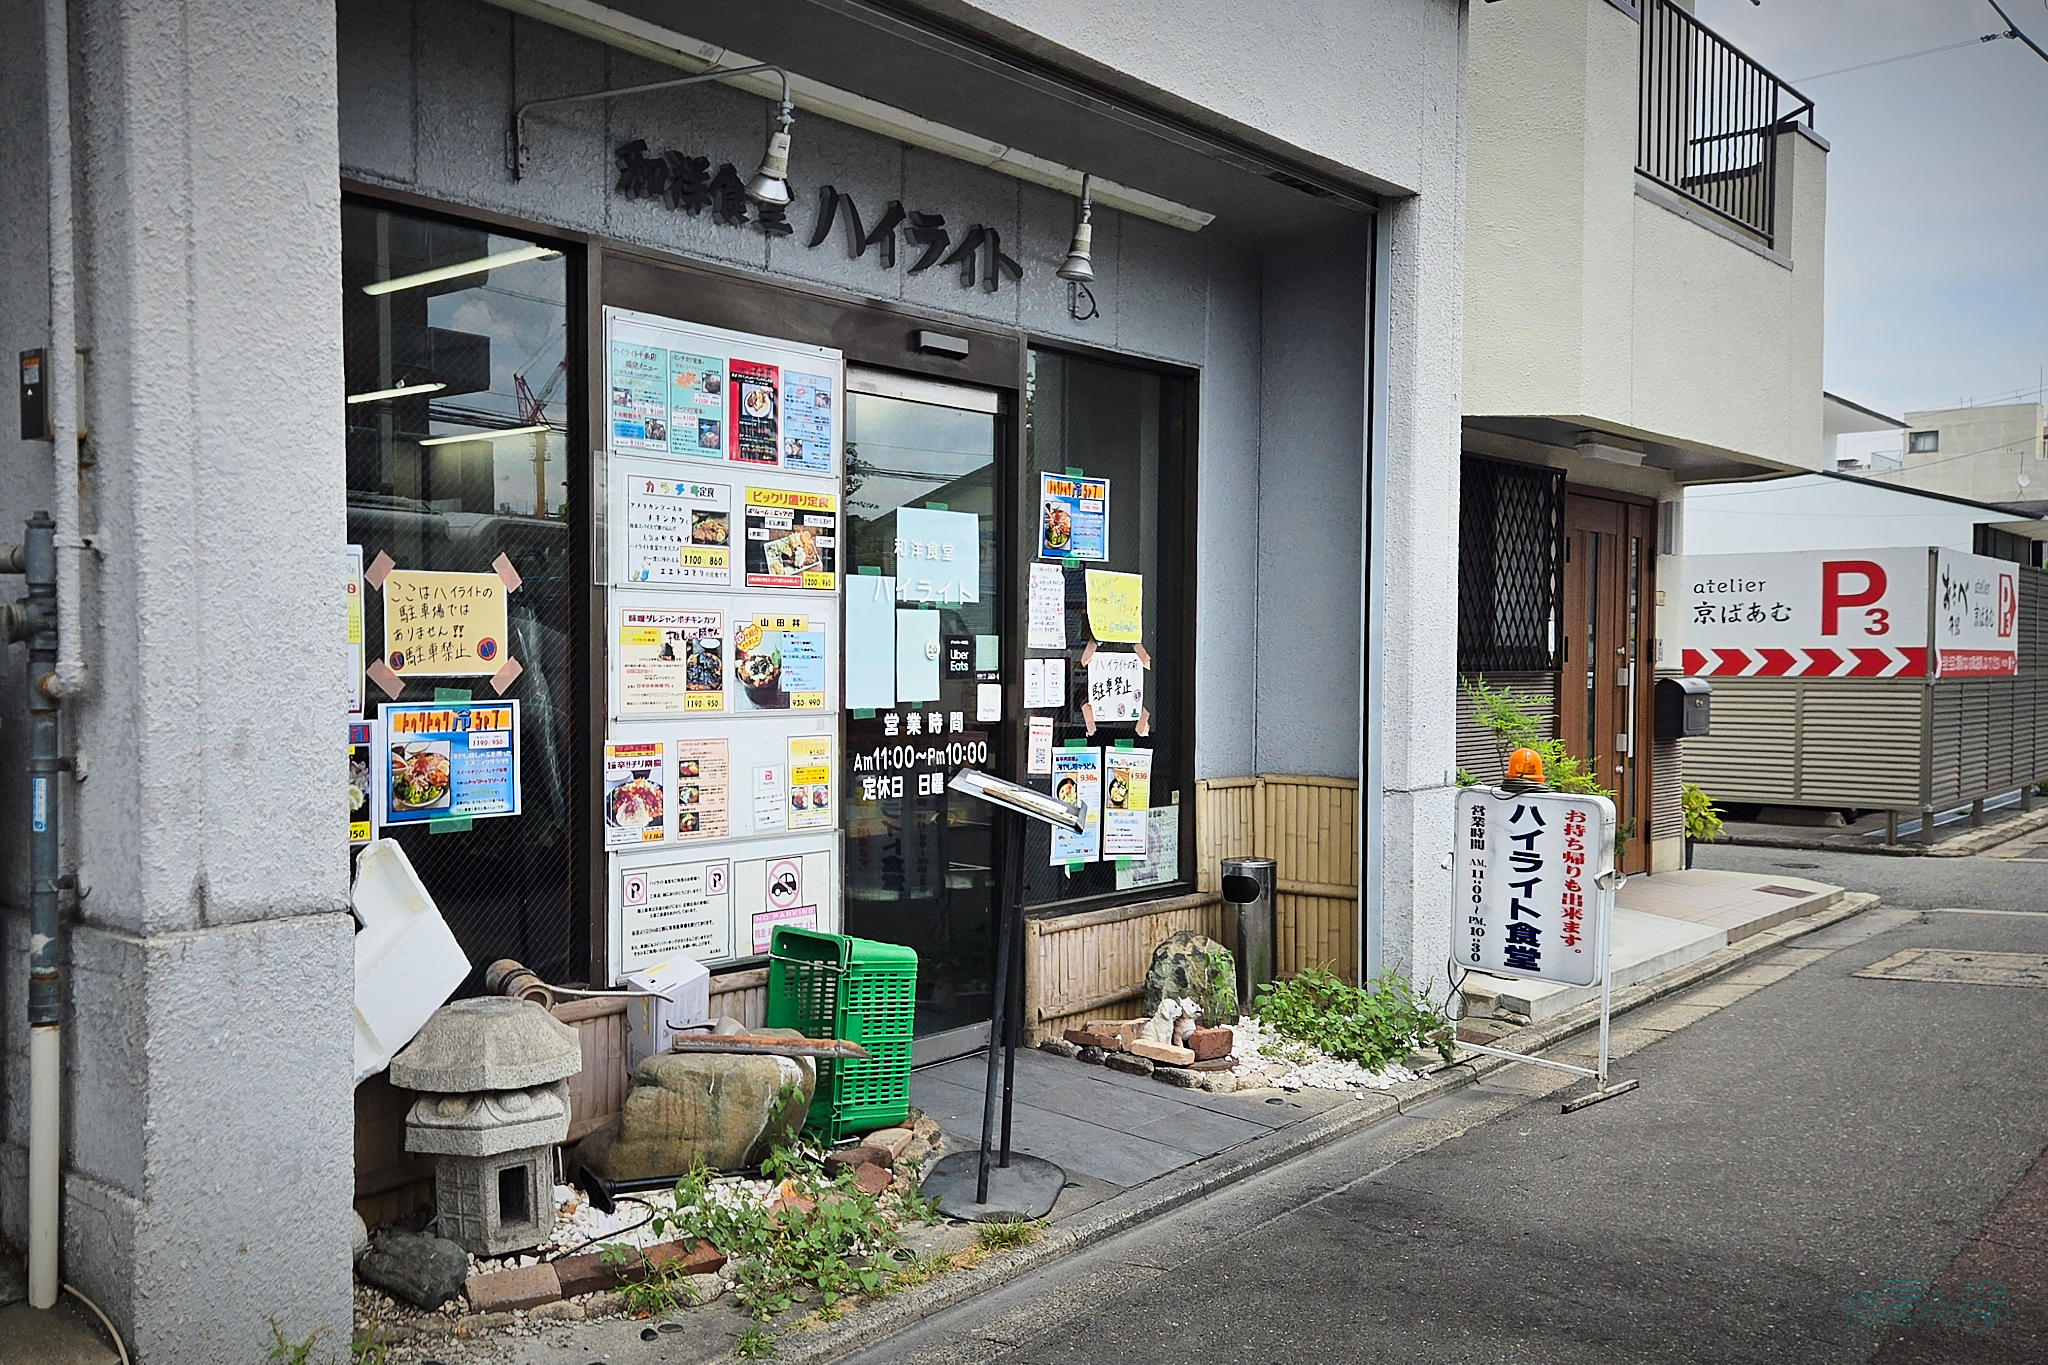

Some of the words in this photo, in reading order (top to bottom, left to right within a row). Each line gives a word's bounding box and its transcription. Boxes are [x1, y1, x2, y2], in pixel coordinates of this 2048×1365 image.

[808, 185, 1023, 292] ハイライト
[753, 490, 828, 508] ビックリ盛り定食
[894, 538, 954, 561] 和洋食堂
[391, 581, 493, 602] ここはハイライトの
[874, 577, 972, 605] ハイライト
[1693, 578, 1767, 594] atelier
[399, 603, 470, 623] 駐車場では
[1693, 601, 1792, 625] 京ばあむ
[405, 641, 472, 666] 駐車禁止
[950, 649, 969, 660] Uber
[950, 661, 969, 671] Eats
[1093, 676, 1132, 701] 駐車禁止
[884, 711, 964, 736] 営業時間
[862, 775, 904, 801] 定休日
[919, 772, 944, 796] 日曜
[1470, 805, 1486, 851] 営業時間
[1504, 804, 1546, 972] ハイライト食堂
[1560, 809, 1587, 954] お持ち帰りも出来ます。
[756, 915, 769, 923] NO
[773, 907, 814, 920] PARKING
